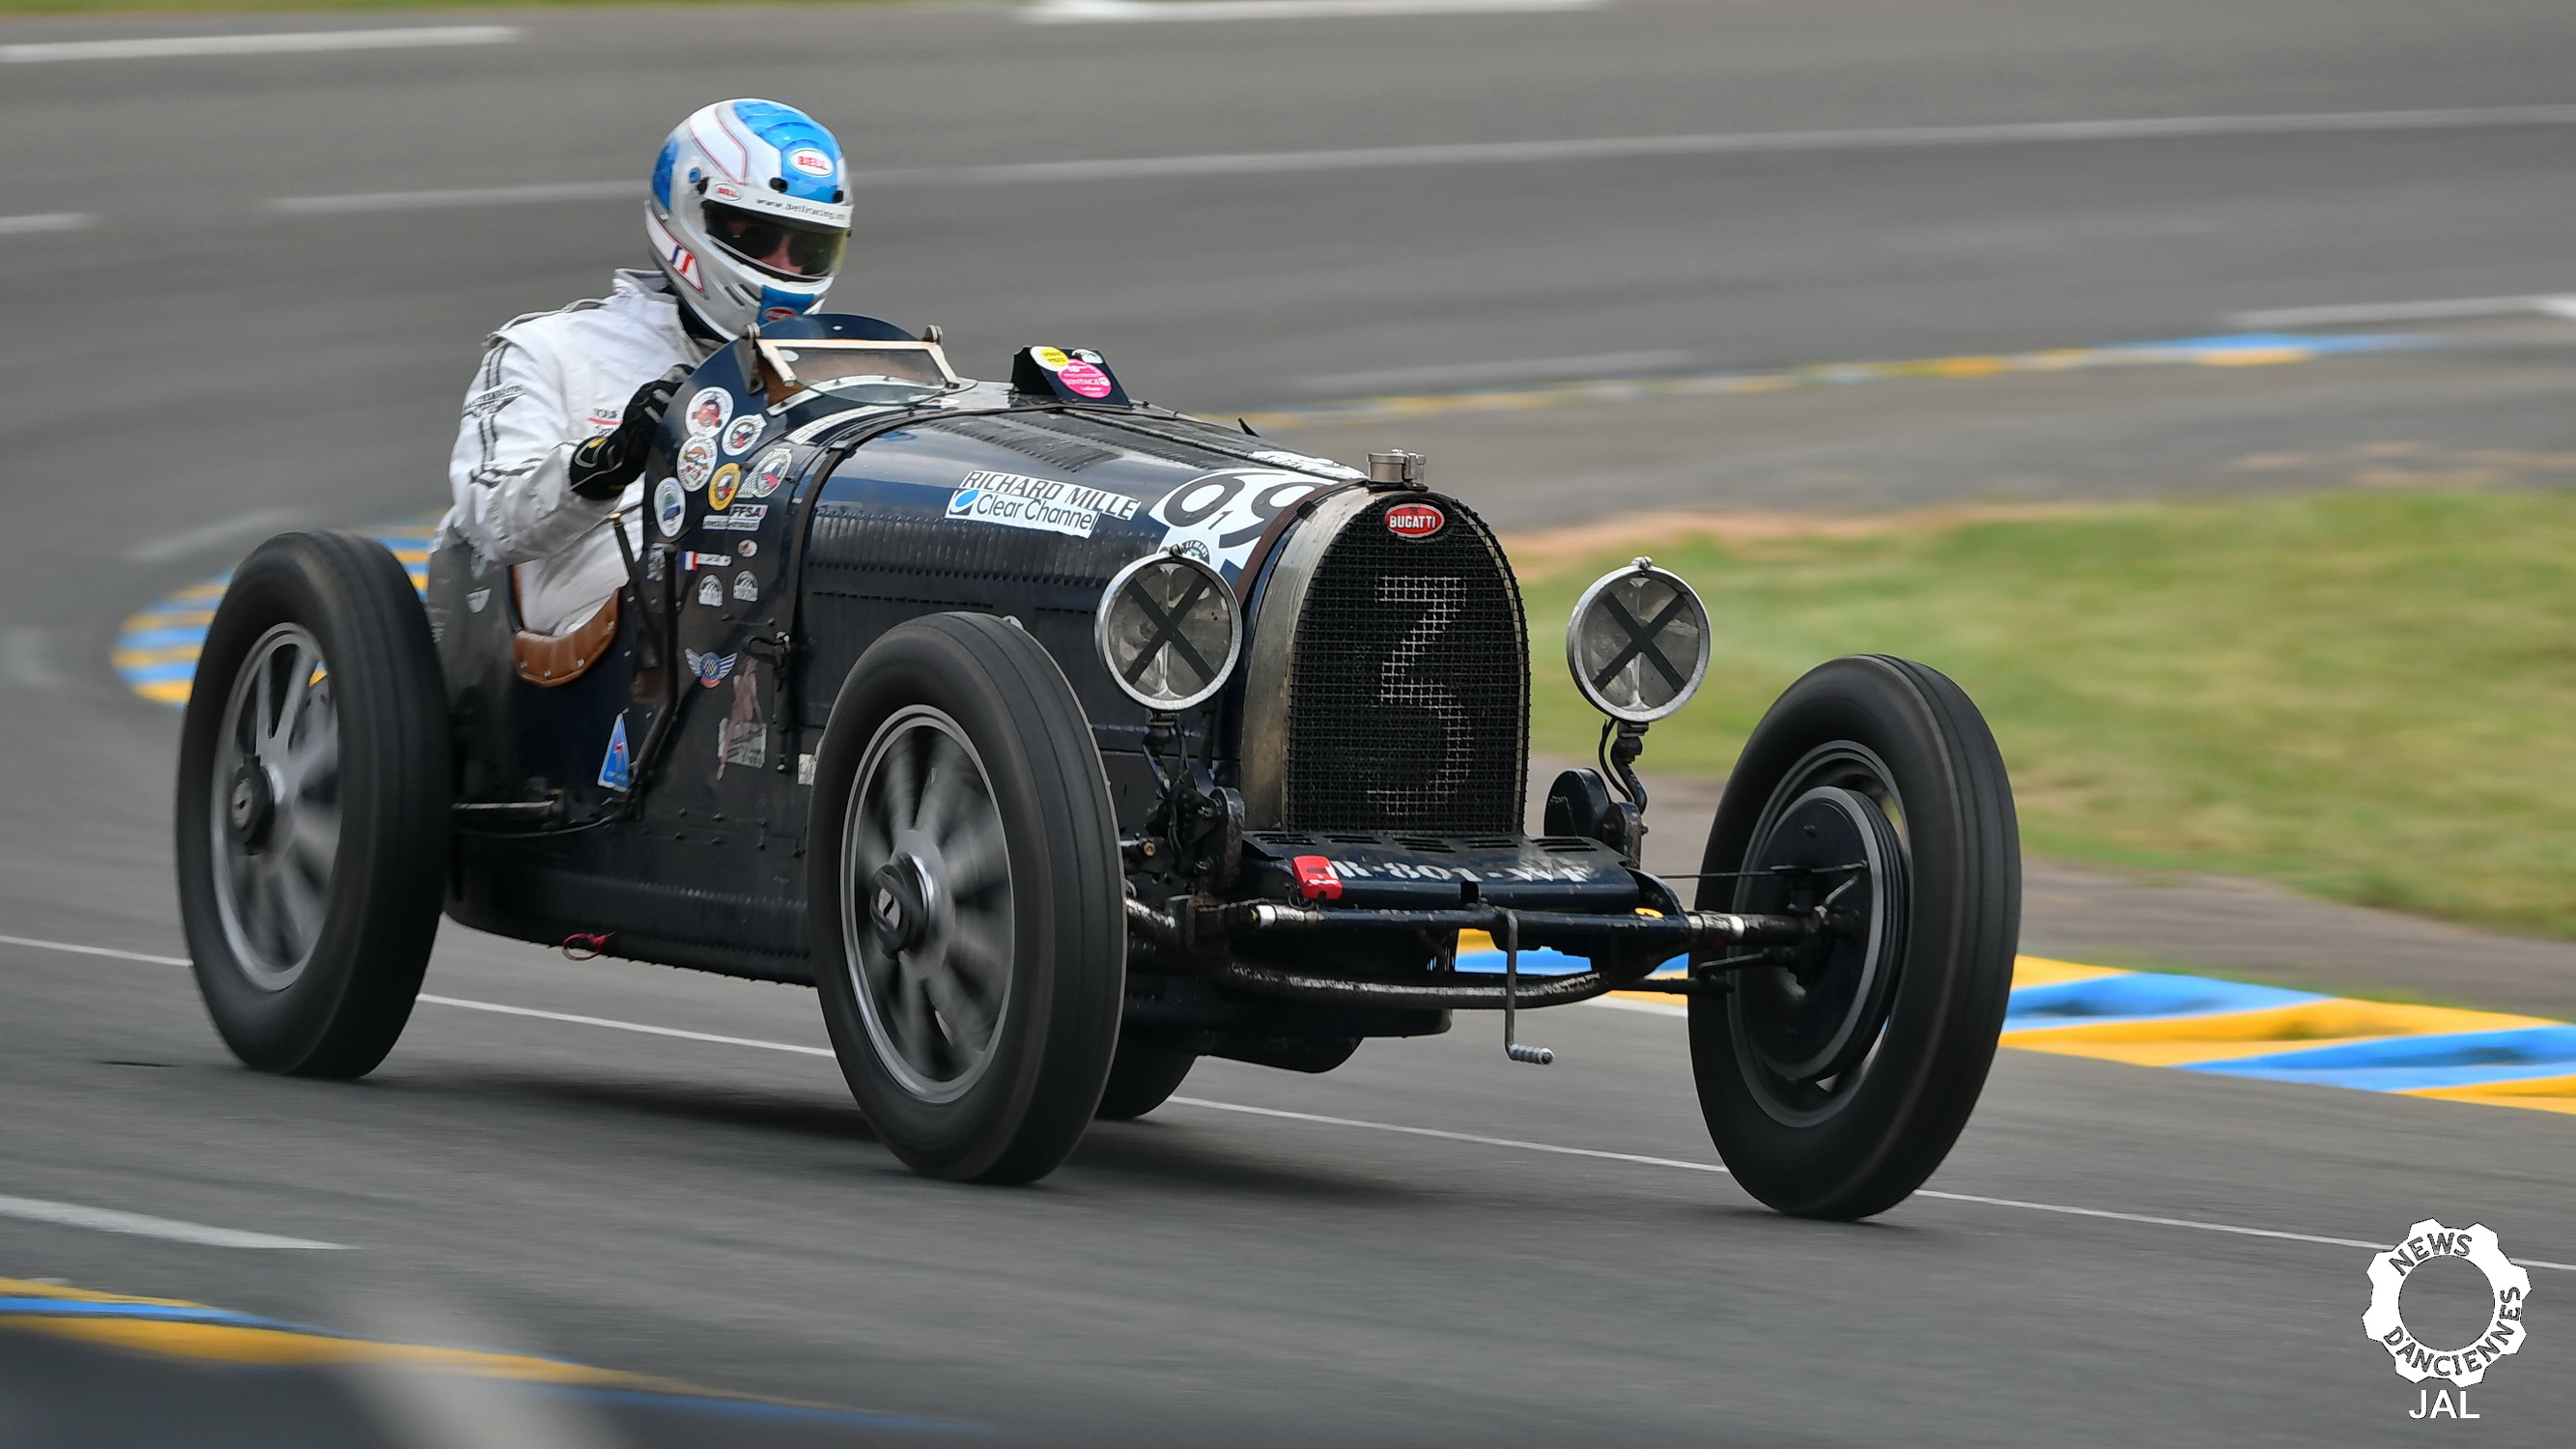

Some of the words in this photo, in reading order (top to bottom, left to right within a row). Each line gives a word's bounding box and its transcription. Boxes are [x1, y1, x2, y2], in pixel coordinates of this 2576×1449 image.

[798, 156, 828, 171] BELL
[961, 471, 1064, 500] RICHARD
[1064, 487, 1140, 519] MILLE
[729, 506, 762, 518] FFSA
[977, 494, 1023, 519] Clear
[1024, 498, 1094, 531] Channel
[1389, 515, 1436, 528] BUGATTI
[1368, 576, 1474, 816] 3
